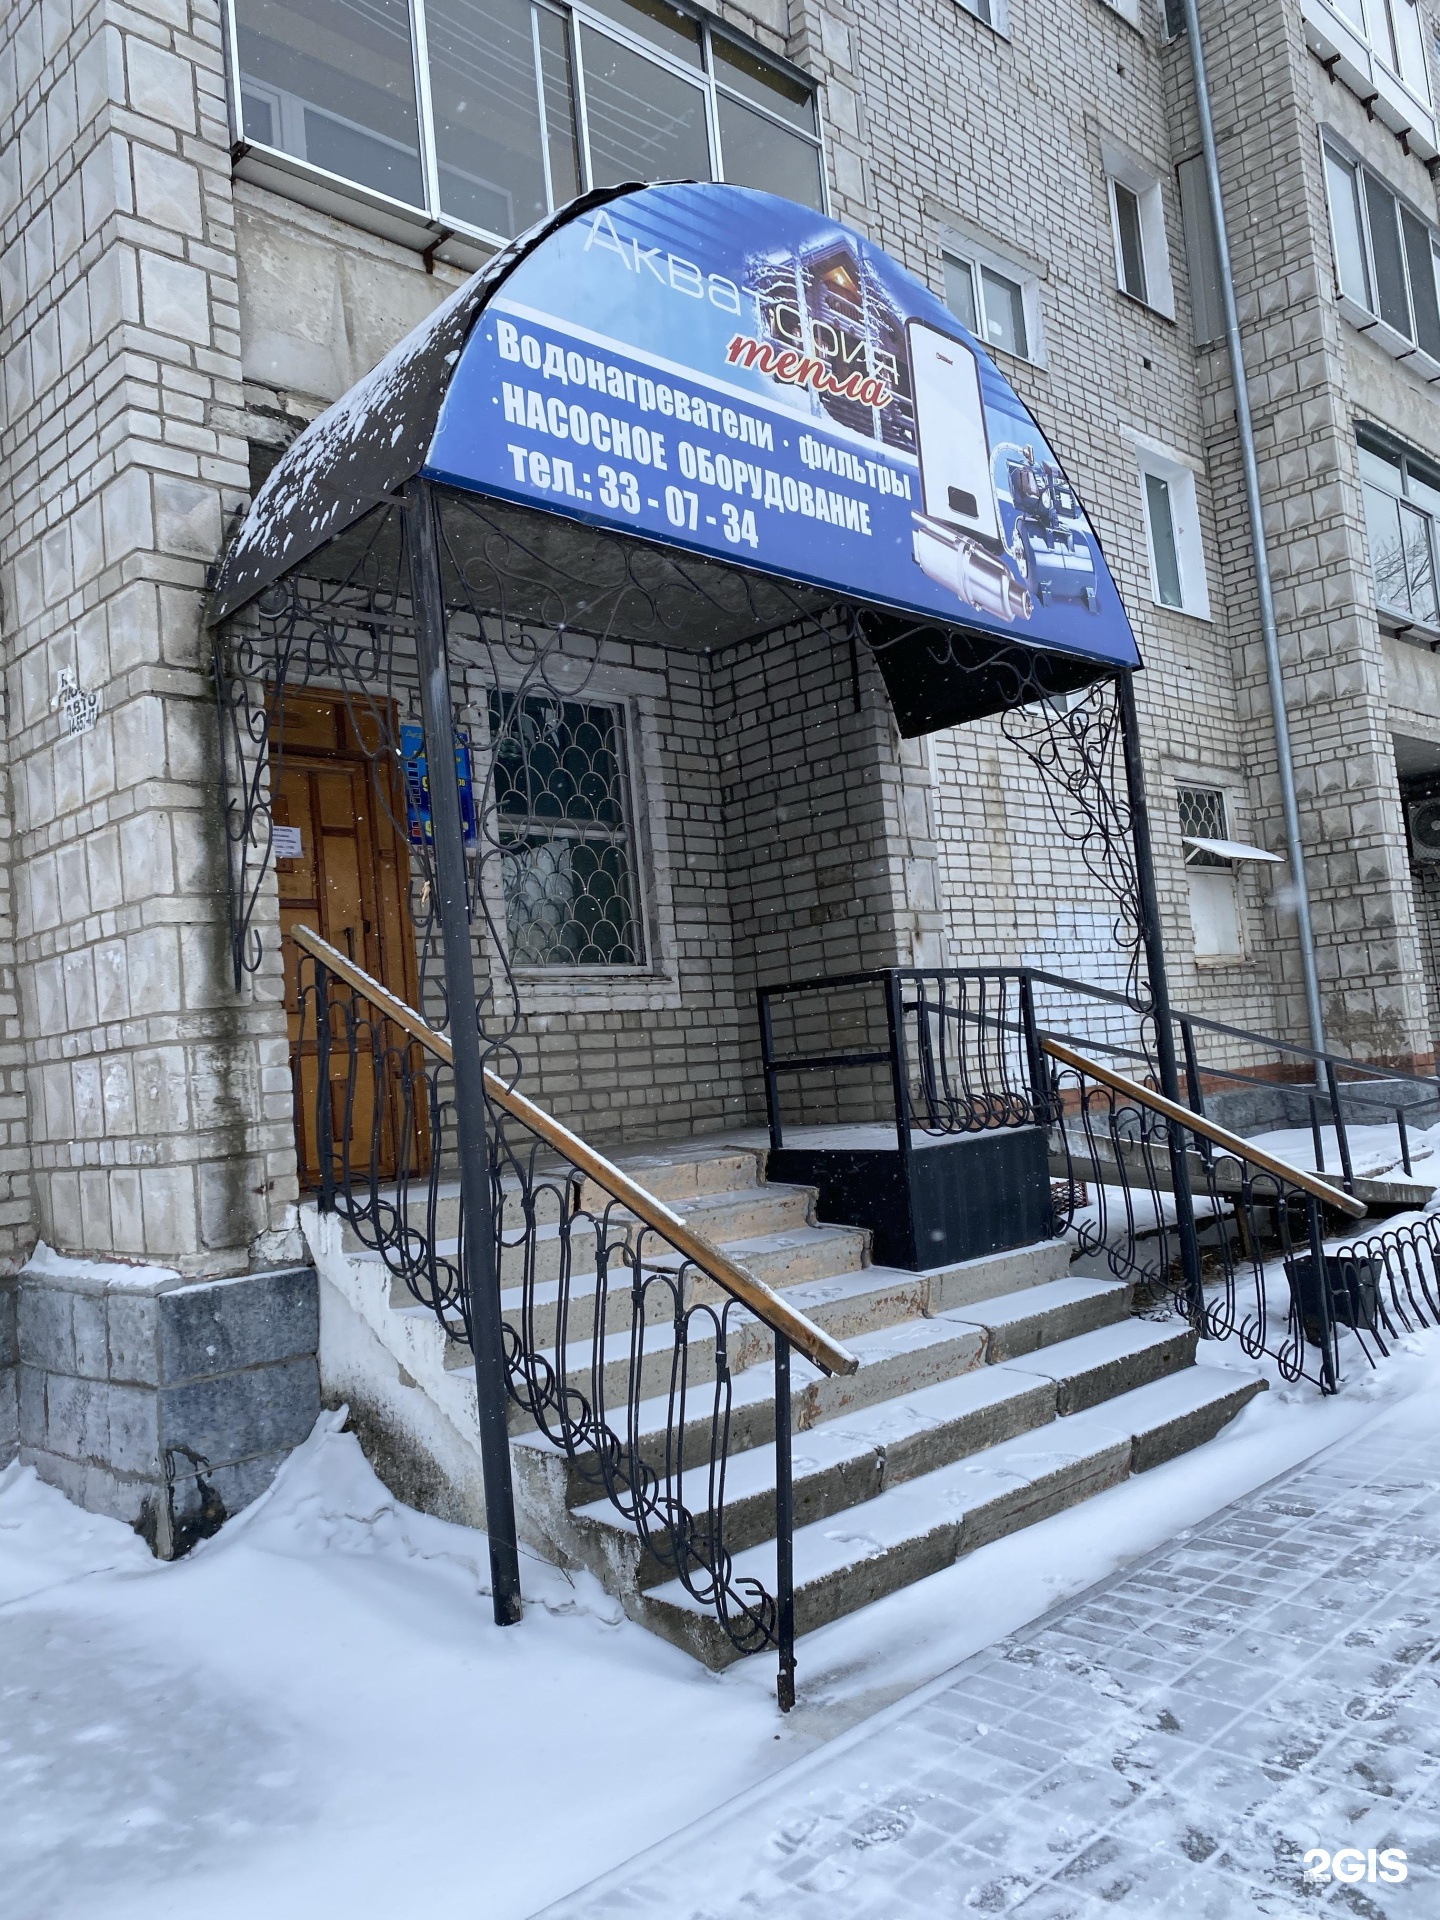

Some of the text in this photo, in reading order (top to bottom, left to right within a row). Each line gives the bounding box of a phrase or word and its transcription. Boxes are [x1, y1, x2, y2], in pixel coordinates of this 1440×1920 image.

[495, 318, 912, 501] Водонагреватели фильтры
[725, 333, 894, 410] тепла
[502, 381, 873, 537] НАСОСНОЕ ОБОРУДОВАНИЕ
[507, 443, 592, 501] тел.:
[67, 694, 97, 717] АВТО
